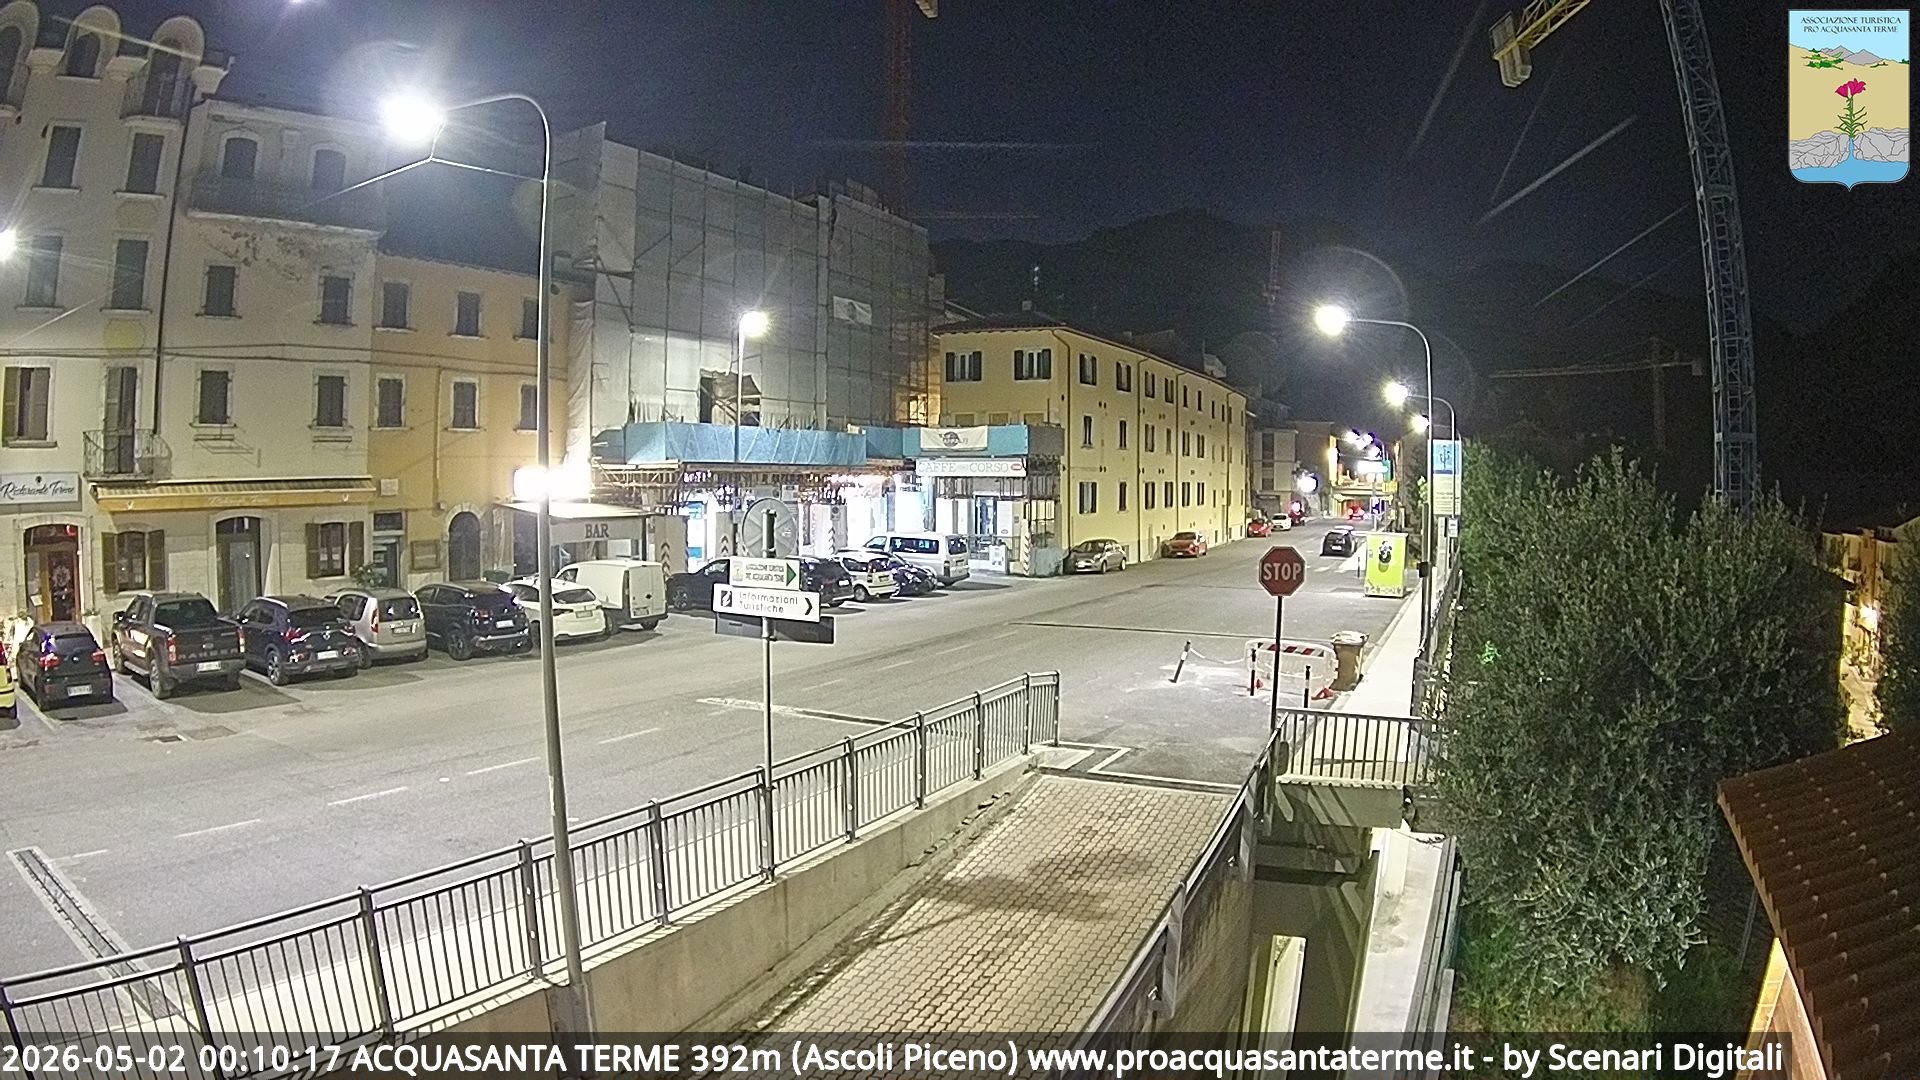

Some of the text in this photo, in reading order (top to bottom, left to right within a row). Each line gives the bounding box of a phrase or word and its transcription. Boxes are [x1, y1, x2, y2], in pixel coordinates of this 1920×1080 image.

[970, 462, 1009, 473] CORSO
[584, 523, 609, 538] BAR
[1263, 562, 1302, 580] STOP
[739, 591, 798, 605] Informazioni
